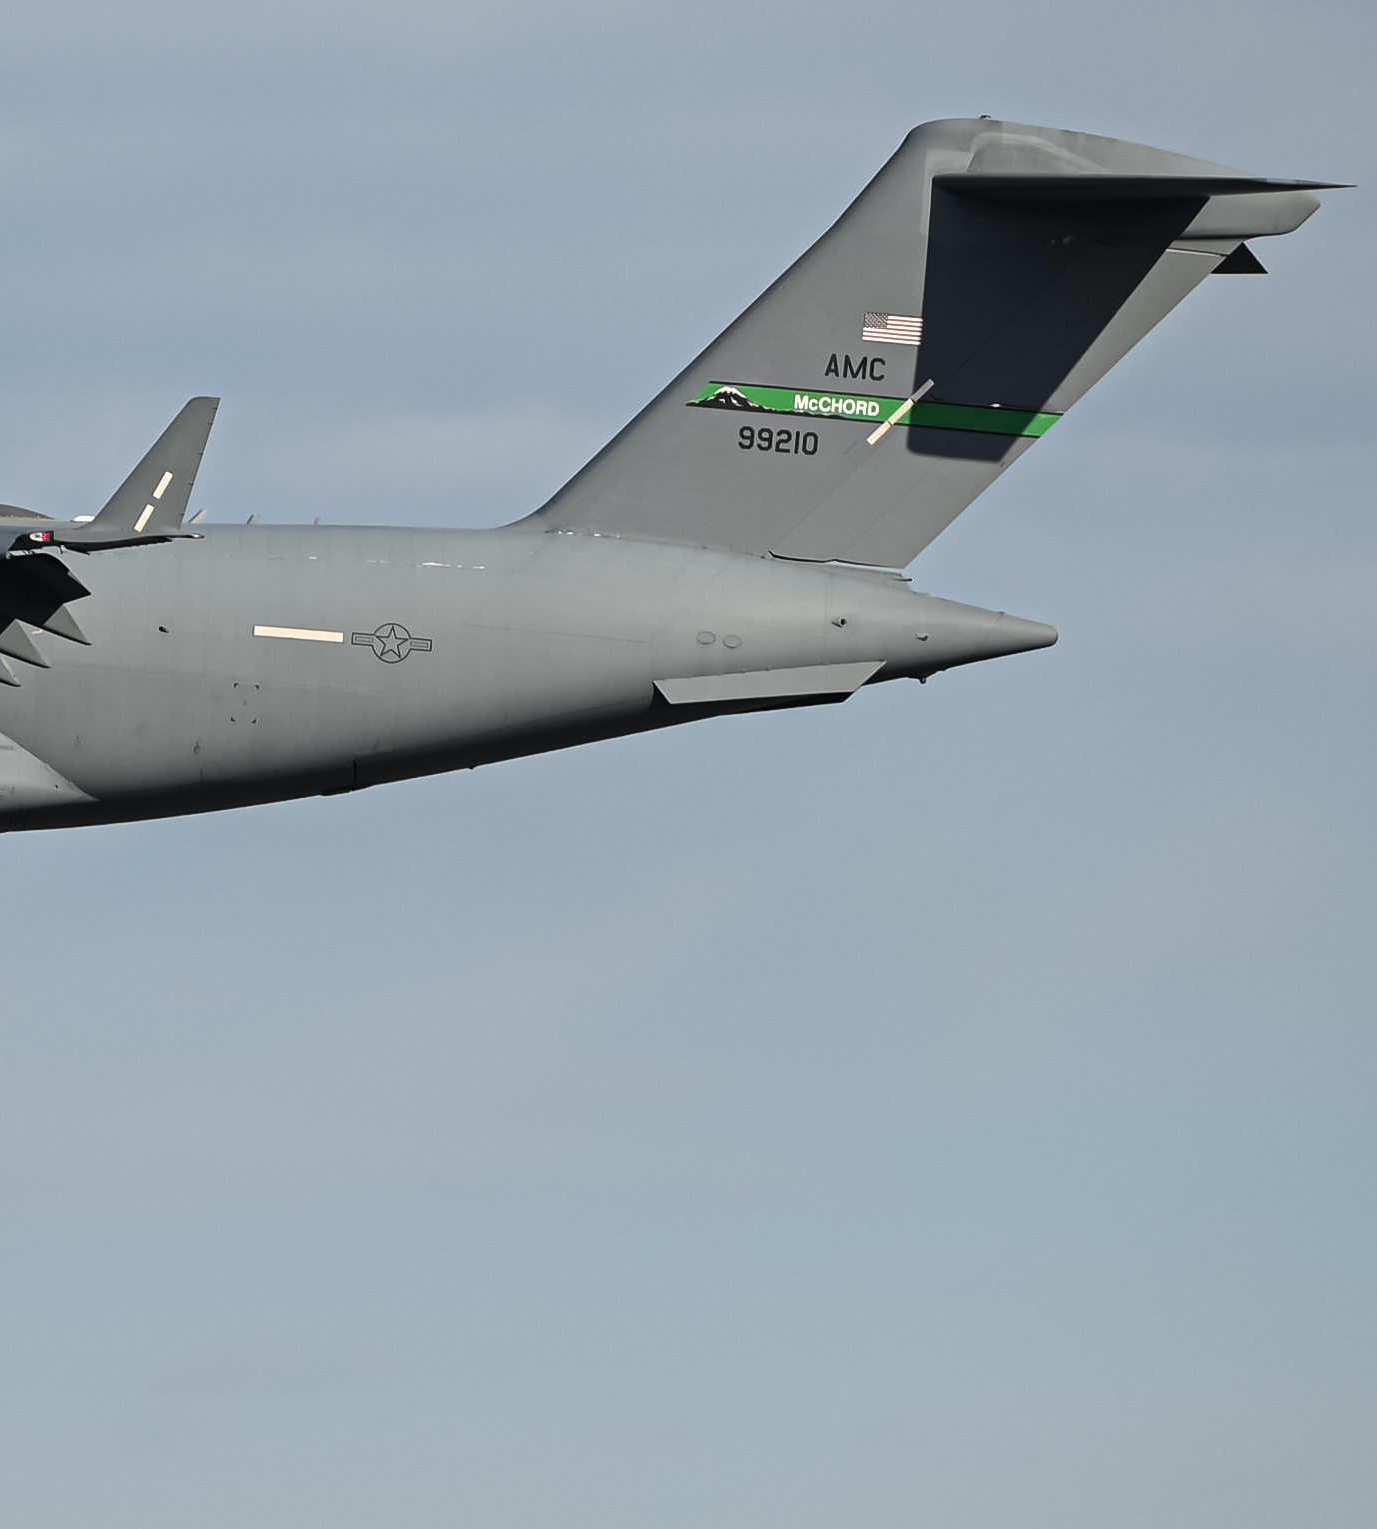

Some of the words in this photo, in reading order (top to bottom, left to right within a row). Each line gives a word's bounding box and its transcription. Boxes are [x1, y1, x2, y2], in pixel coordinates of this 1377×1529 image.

[825, 353, 886, 381] AMC
[794, 394, 880, 416] McCHORD
[738, 425, 819, 455] 99210
